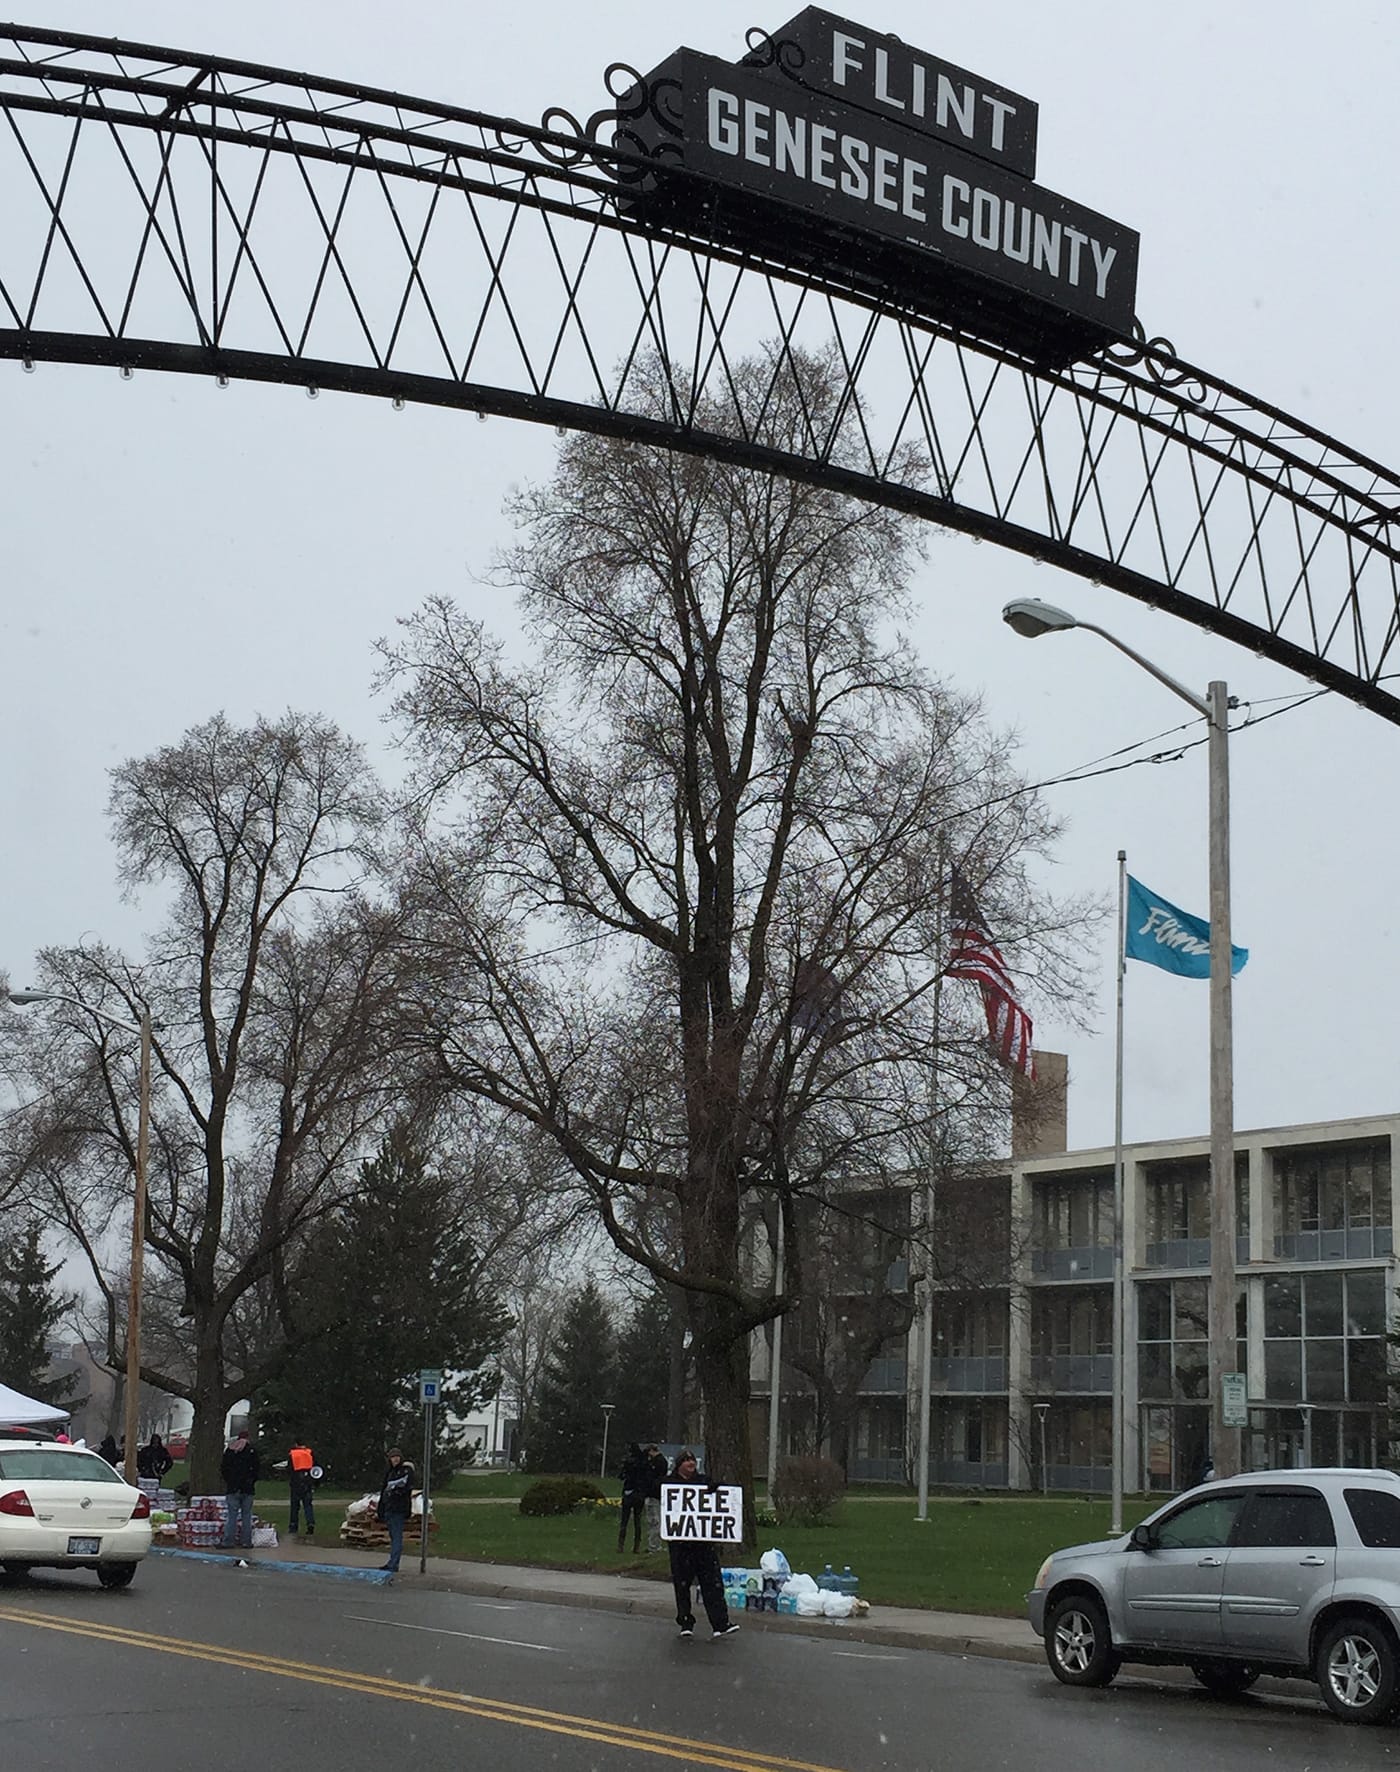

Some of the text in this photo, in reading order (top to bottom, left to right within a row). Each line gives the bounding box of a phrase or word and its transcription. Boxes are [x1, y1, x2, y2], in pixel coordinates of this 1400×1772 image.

[832, 30, 1016, 152] FLINT
[707, 87, 1117, 298] GENESEE COUNTY
[666, 1515, 735, 1538] WATER
[667, 1488, 729, 1512] FREE
